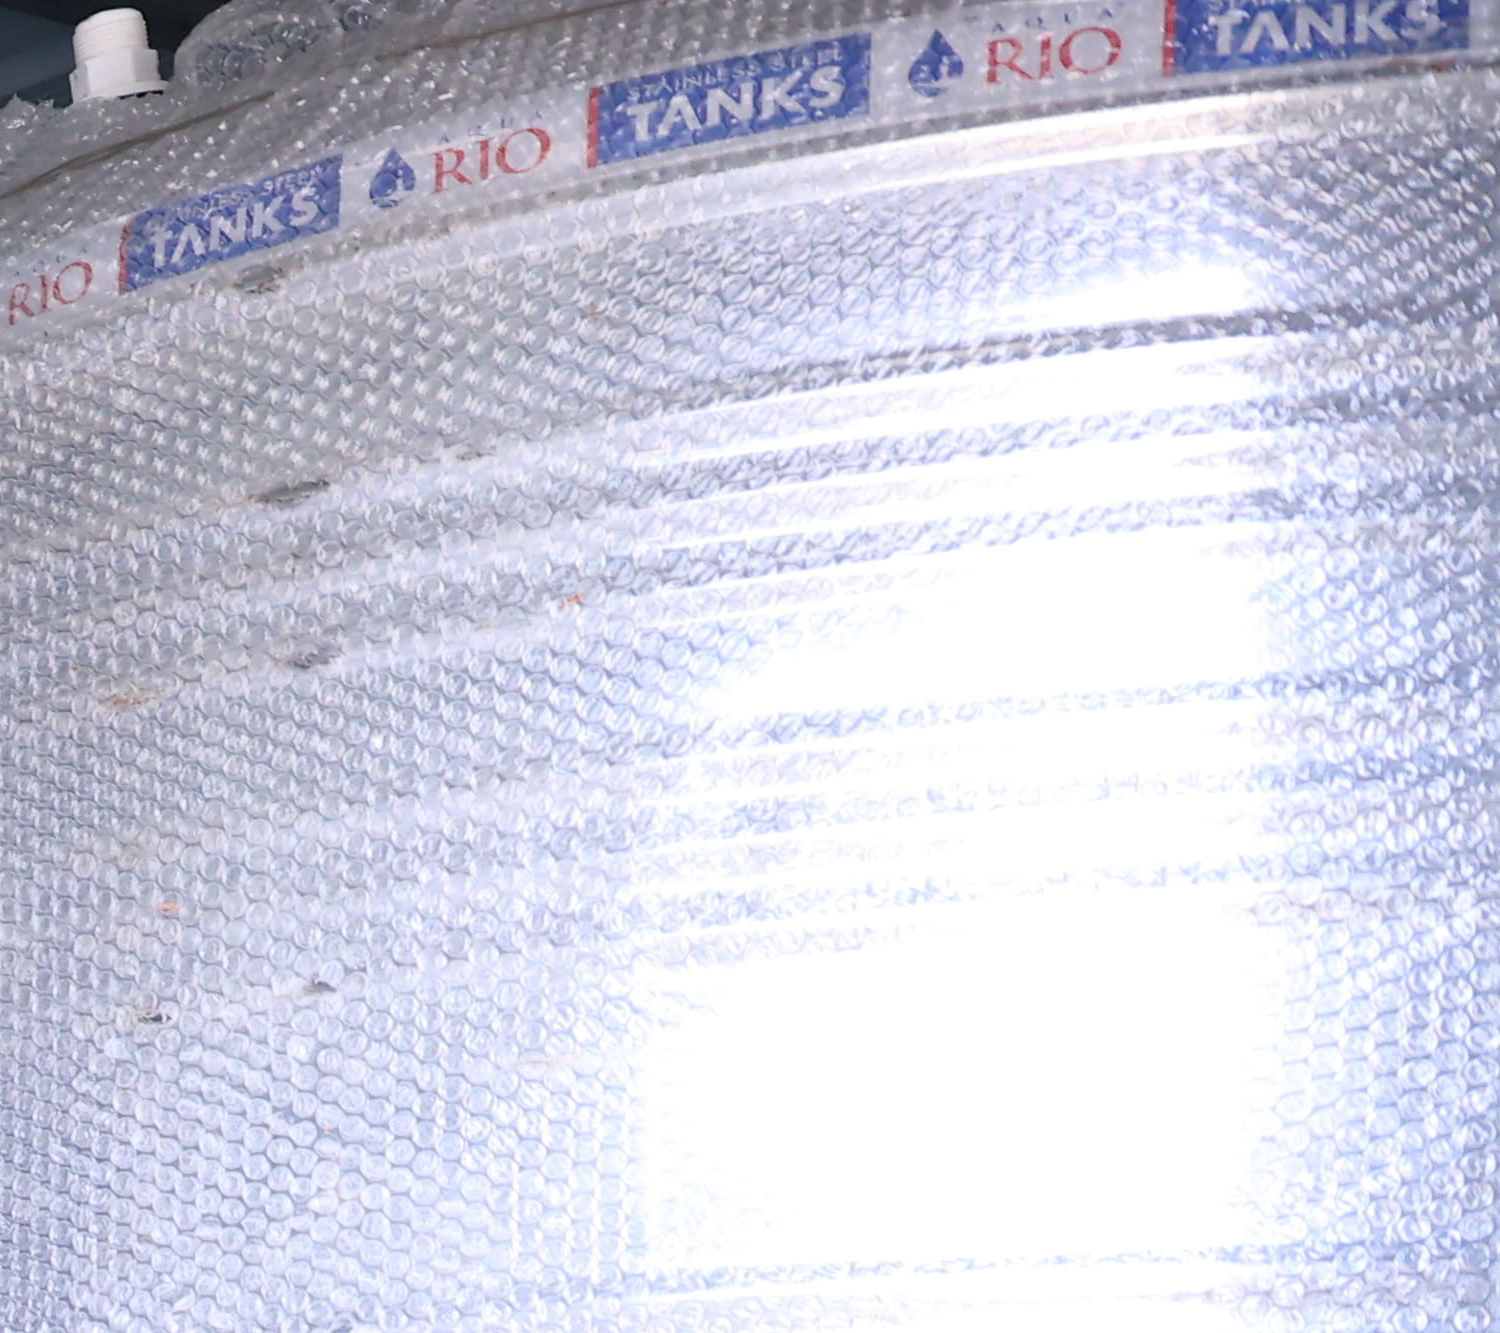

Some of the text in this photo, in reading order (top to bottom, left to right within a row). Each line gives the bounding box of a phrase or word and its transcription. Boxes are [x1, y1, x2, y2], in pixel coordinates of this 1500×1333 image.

[986, 0, 1442, 85] RIO TANKS
[433, 64, 848, 194] RIO TANKS
[9, 261, 94, 325] RIO
[151, 188, 321, 268] TANKS
